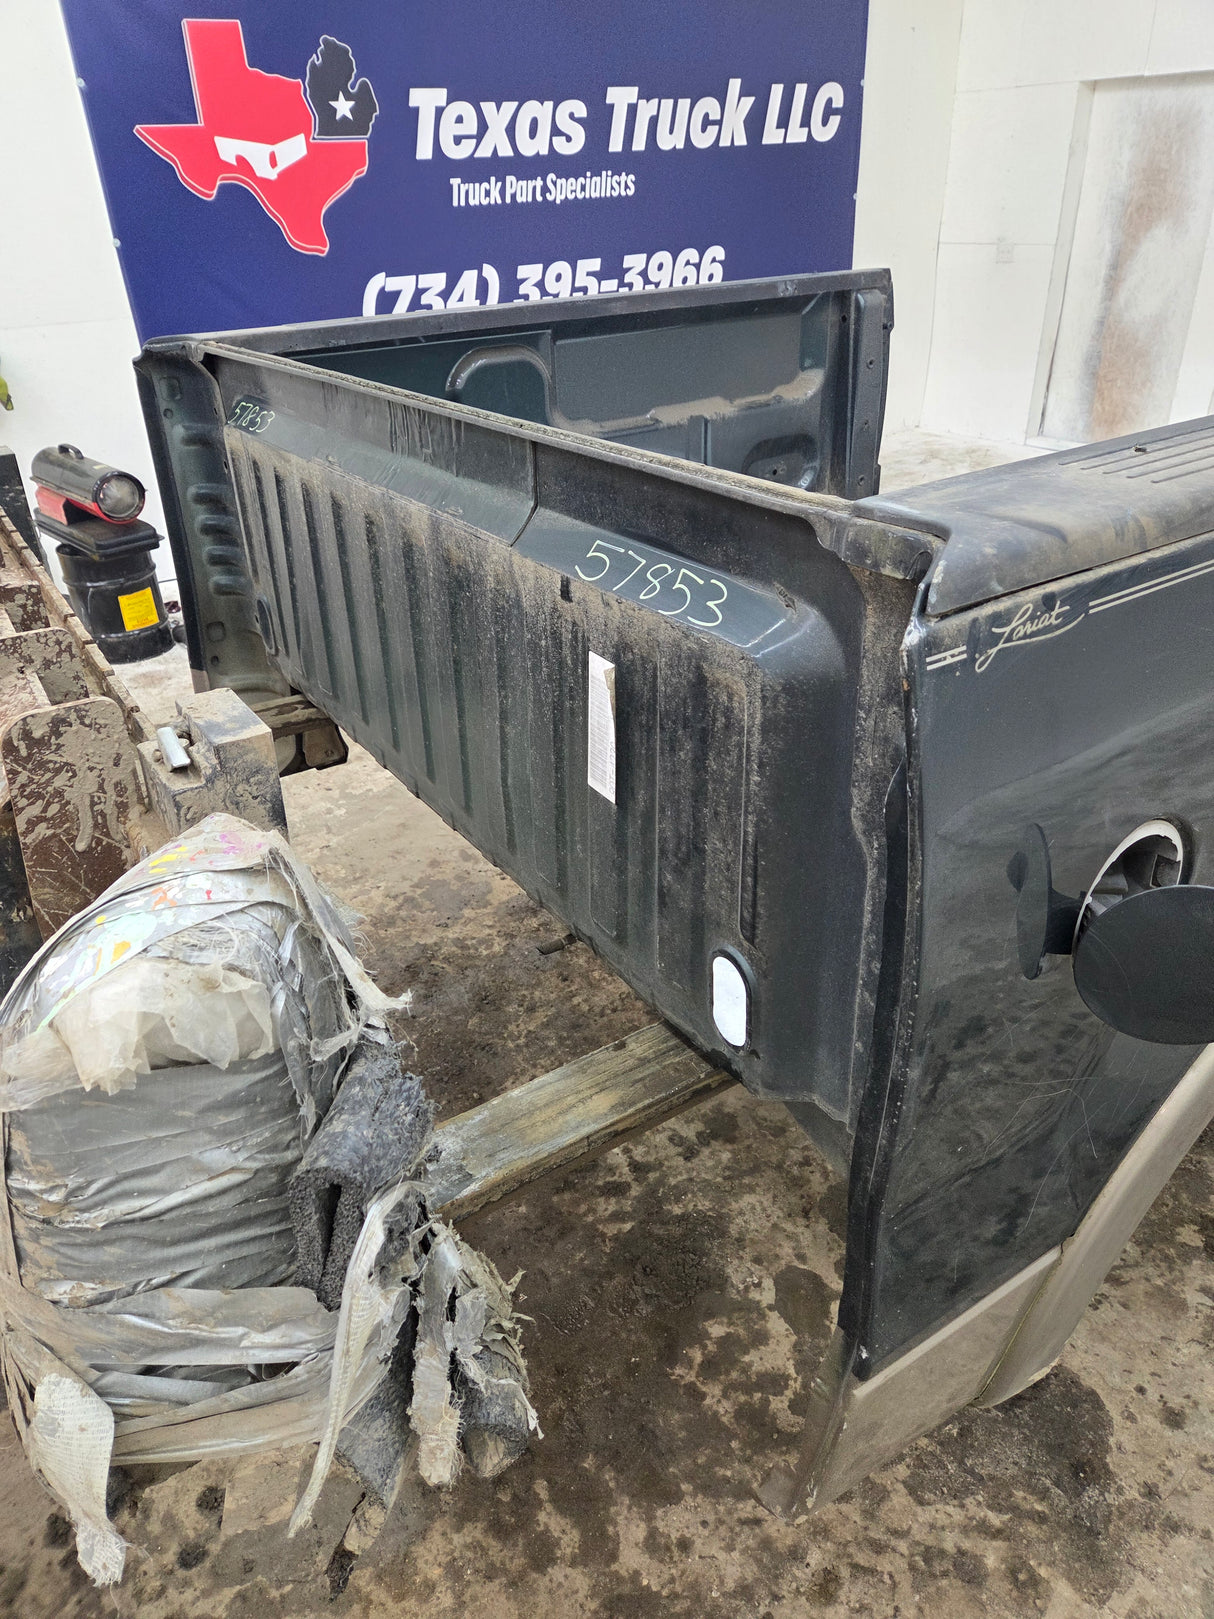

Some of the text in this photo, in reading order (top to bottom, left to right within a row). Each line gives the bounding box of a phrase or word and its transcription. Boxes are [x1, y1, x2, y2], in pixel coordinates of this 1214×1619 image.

[409, 78, 845, 160] Texas Truck LLC
[450, 170, 636, 207] Truck Part Specialists
[362, 245, 726, 317] (734) 395-3966
[227, 401, 276, 433] 57853
[574, 539, 728, 627] 57853
[975, 600, 1085, 673] Lariat
